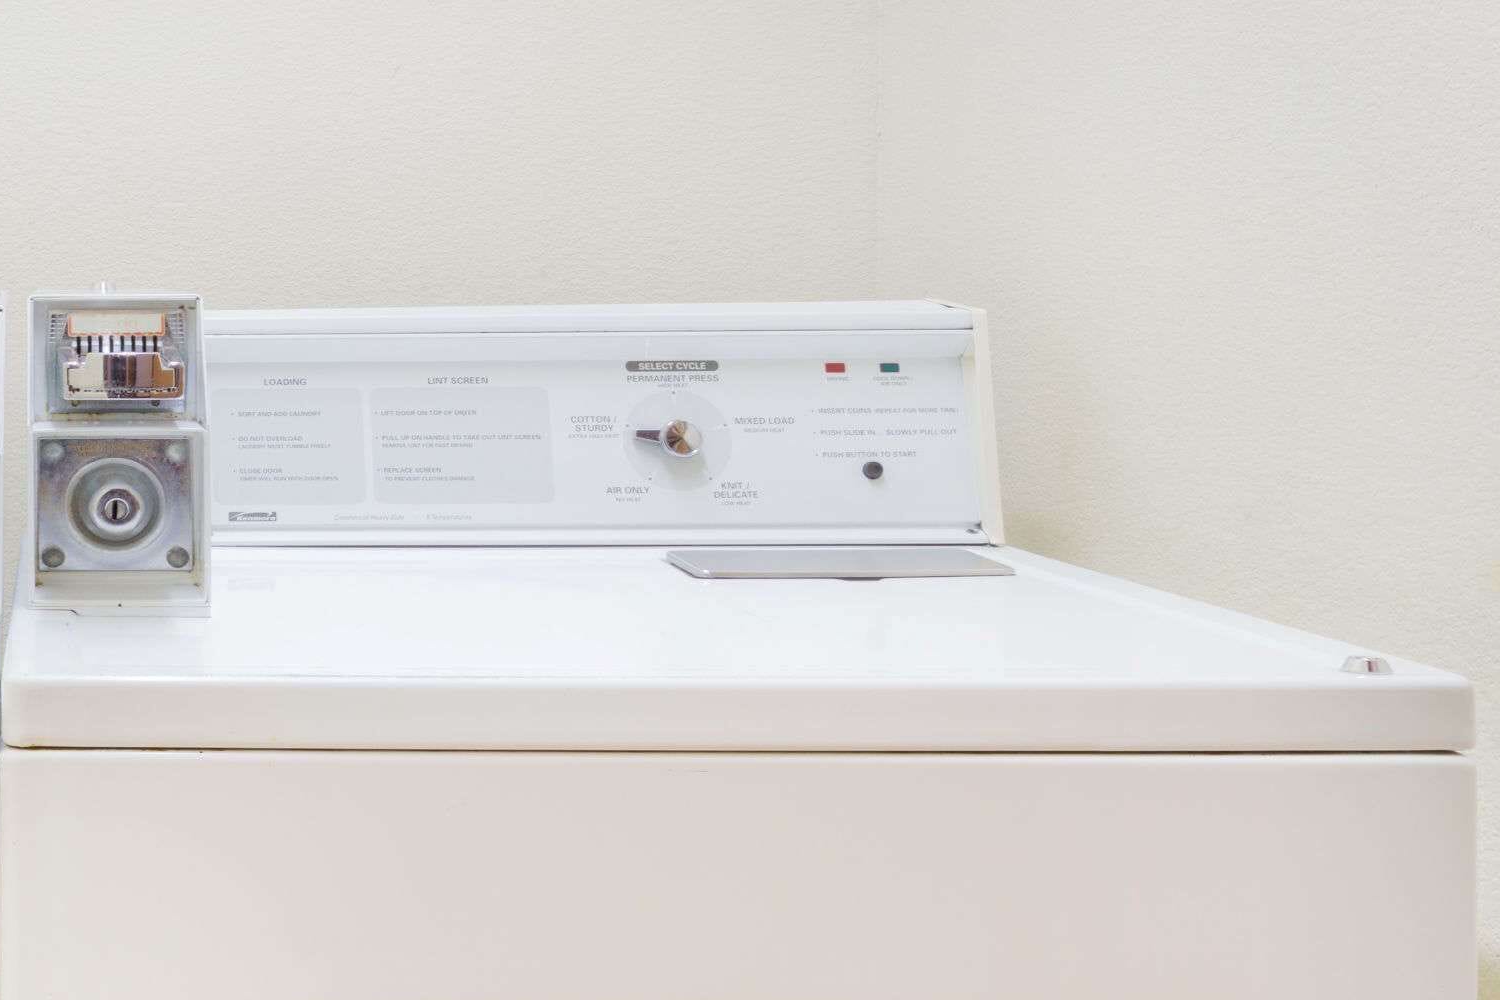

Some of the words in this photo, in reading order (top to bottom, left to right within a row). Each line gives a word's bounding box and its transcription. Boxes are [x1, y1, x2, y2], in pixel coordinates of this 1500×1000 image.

[638, 362, 674, 370] SELECT
[675, 362, 707, 370] CYCLE
[263, 377, 308, 386] LOADING
[427, 376, 448, 385] LINT
[451, 376, 489, 385] SCREEN
[626, 374, 686, 383] PERMANENT
[688, 374, 719, 383] PRESS
[734, 417, 766, 425] MIXED
[768, 417, 795, 425] LOAD
[575, 424, 614, 432] STURDY
[605, 487, 622, 495] AIR
[624, 487, 650, 495] ONLY
[713, 491, 759, 499] DELICATE
